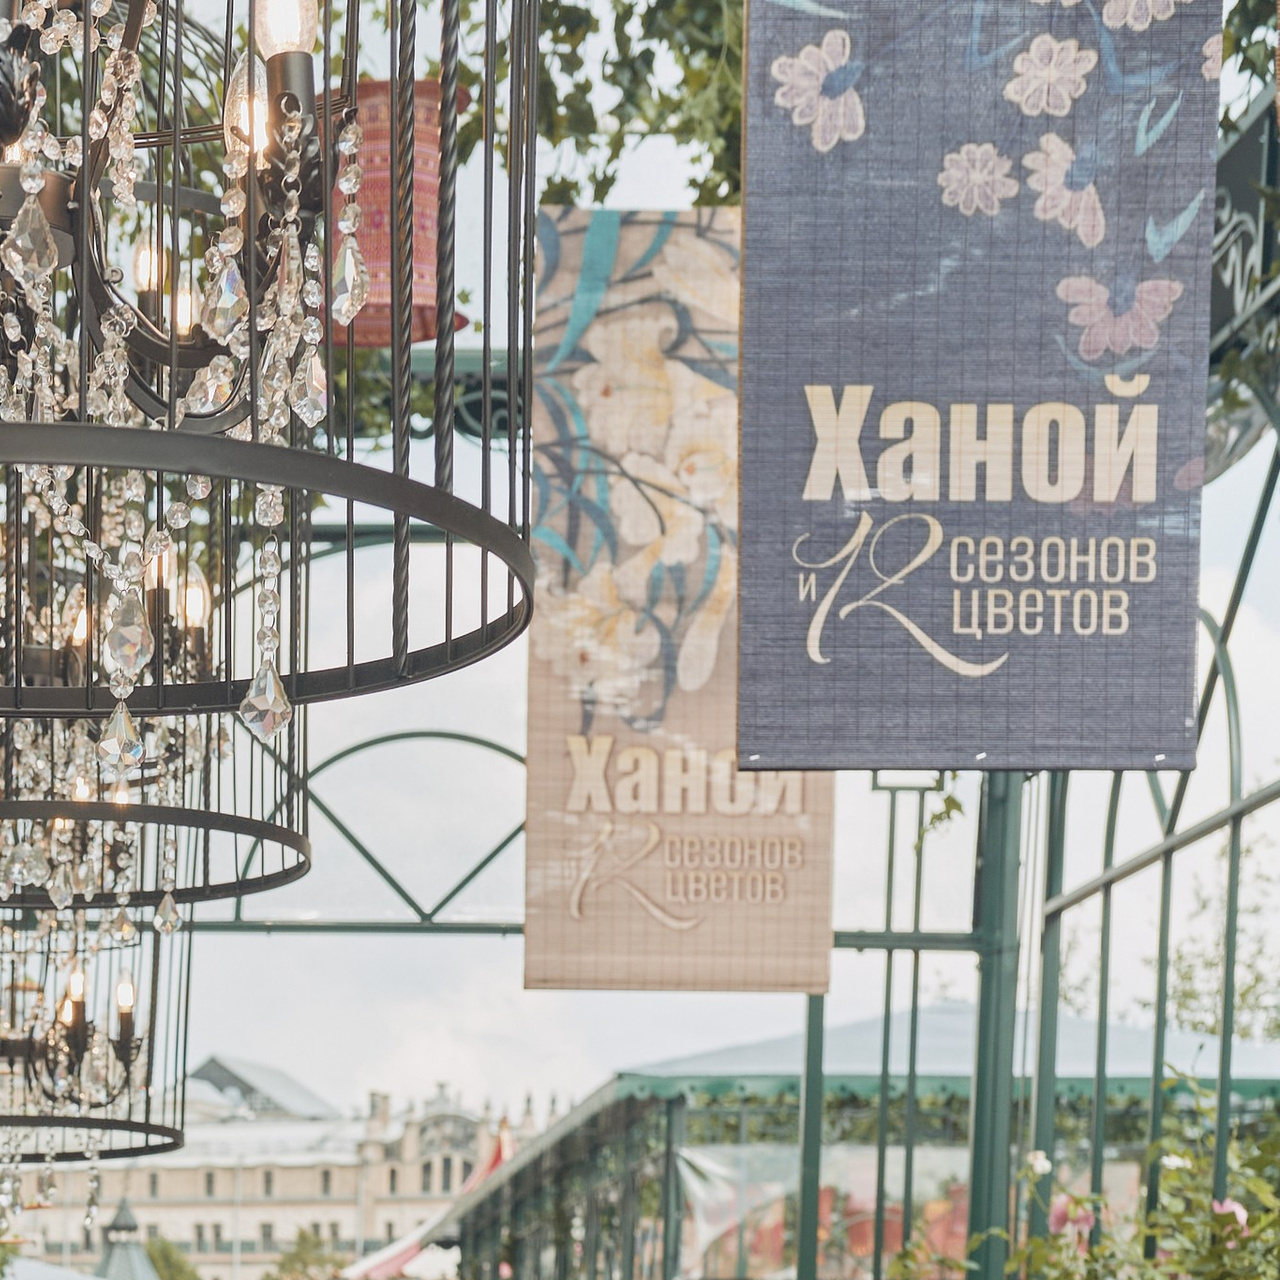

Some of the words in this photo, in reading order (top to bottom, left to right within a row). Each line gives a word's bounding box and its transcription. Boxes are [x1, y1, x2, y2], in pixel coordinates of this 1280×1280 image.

[802, 374, 1159, 503] Ханой
[950, 536, 1157, 583] сезонов
[792, 510, 1009, 677] 12
[798, 572, 816, 601] и
[952, 588, 1129, 640] цветов
[664, 835, 803, 870] сезонов
[666, 871, 785, 904] цветов
